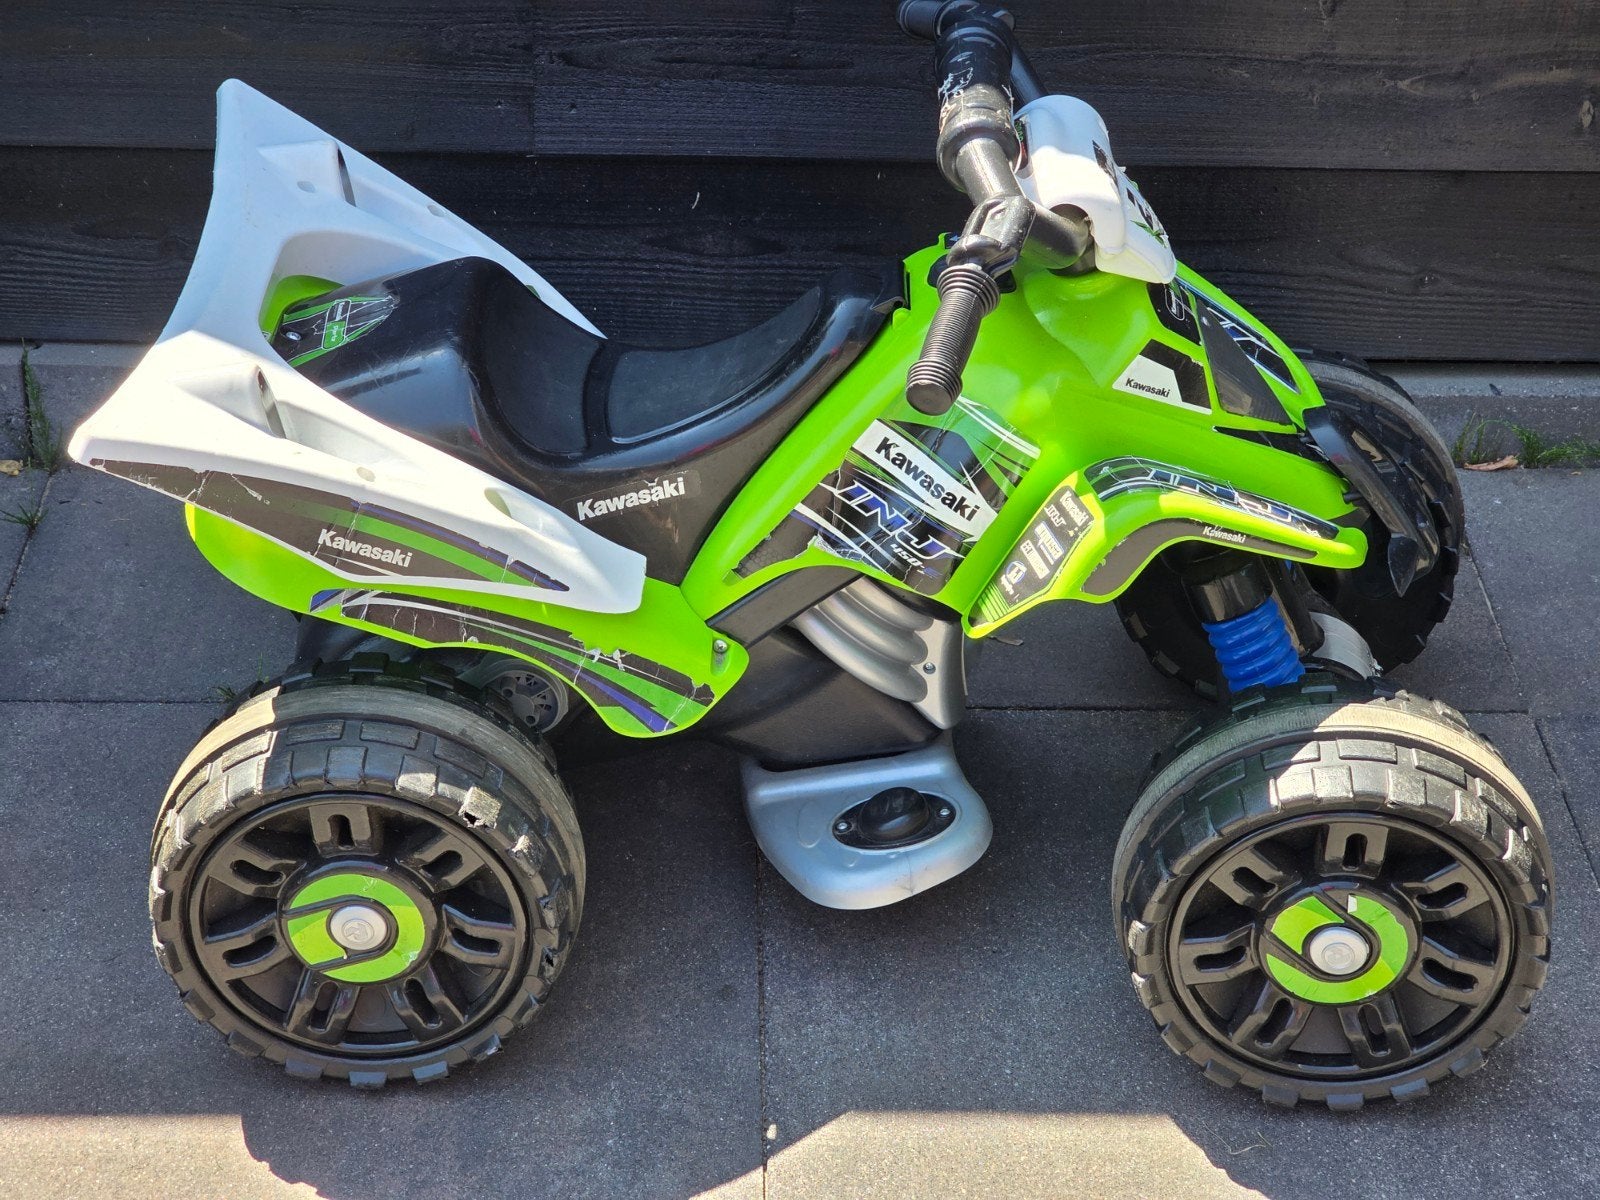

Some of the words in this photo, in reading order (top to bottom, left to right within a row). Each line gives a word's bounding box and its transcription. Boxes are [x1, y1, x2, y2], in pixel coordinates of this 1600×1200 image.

[1125, 378, 1171, 398] Kawasaki
[875, 437, 980, 521] Kawasaki
[576, 477, 685, 521] Kawasaki
[317, 529, 413, 568] Kawasaki
[1202, 526, 1246, 544] Kawasaki
